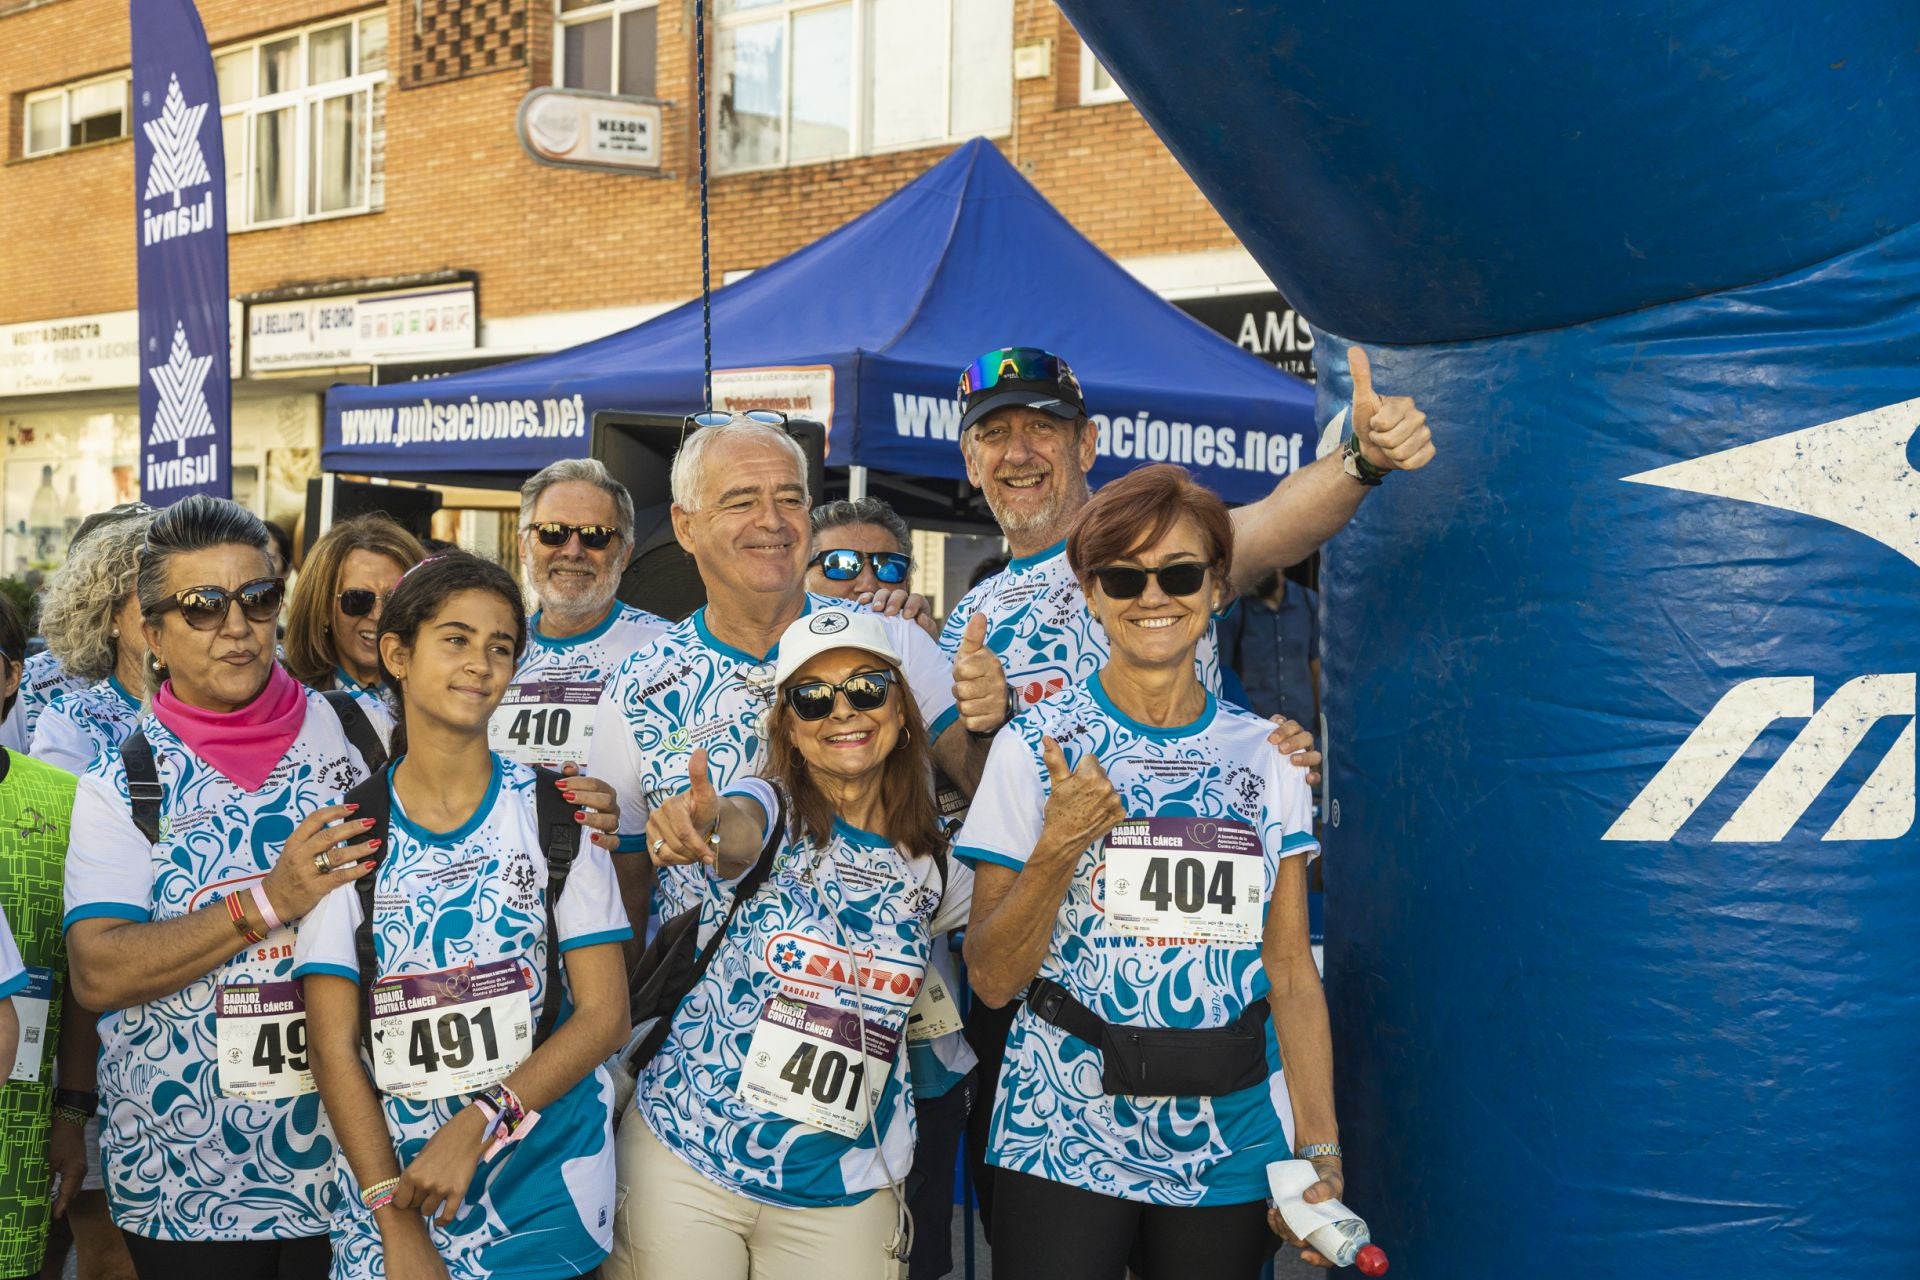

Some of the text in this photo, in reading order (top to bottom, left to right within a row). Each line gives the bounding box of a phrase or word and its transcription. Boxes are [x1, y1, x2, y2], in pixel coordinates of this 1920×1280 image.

[51, 323, 100, 342] DIRECTA
[1237, 310, 1315, 354] AMS
[341, 394, 585, 447] www.pulsaciones.net
[32, 676, 64, 692] luanvi
[508, 708, 571, 746] 410
[317, 766, 328, 783] CLUB
[1225, 770, 1238, 785] CLUB
[1111, 825, 1150, 837] BADAJOZ
[1111, 834, 1183, 847] CONTRA EL CÁNCER
[1139, 857, 1237, 915] 404
[223, 992, 260, 1005] BADAJOZ
[373, 989, 404, 1005] BADAJOZ
[782, 985, 820, 1000] BADAJOZ
[223, 1000, 294, 1015] CONTRA EL CÁNCER
[374, 995, 437, 1015] CONTRA EL CÁNCER
[770, 1000, 807, 1019] BADAJOZ
[839, 997, 888, 1016] REFRIERACIÓN
[768, 1009, 834, 1038] CONTRA EL CÁNCER
[408, 1006, 499, 1074] 491
[780, 1041, 866, 1112] 401
